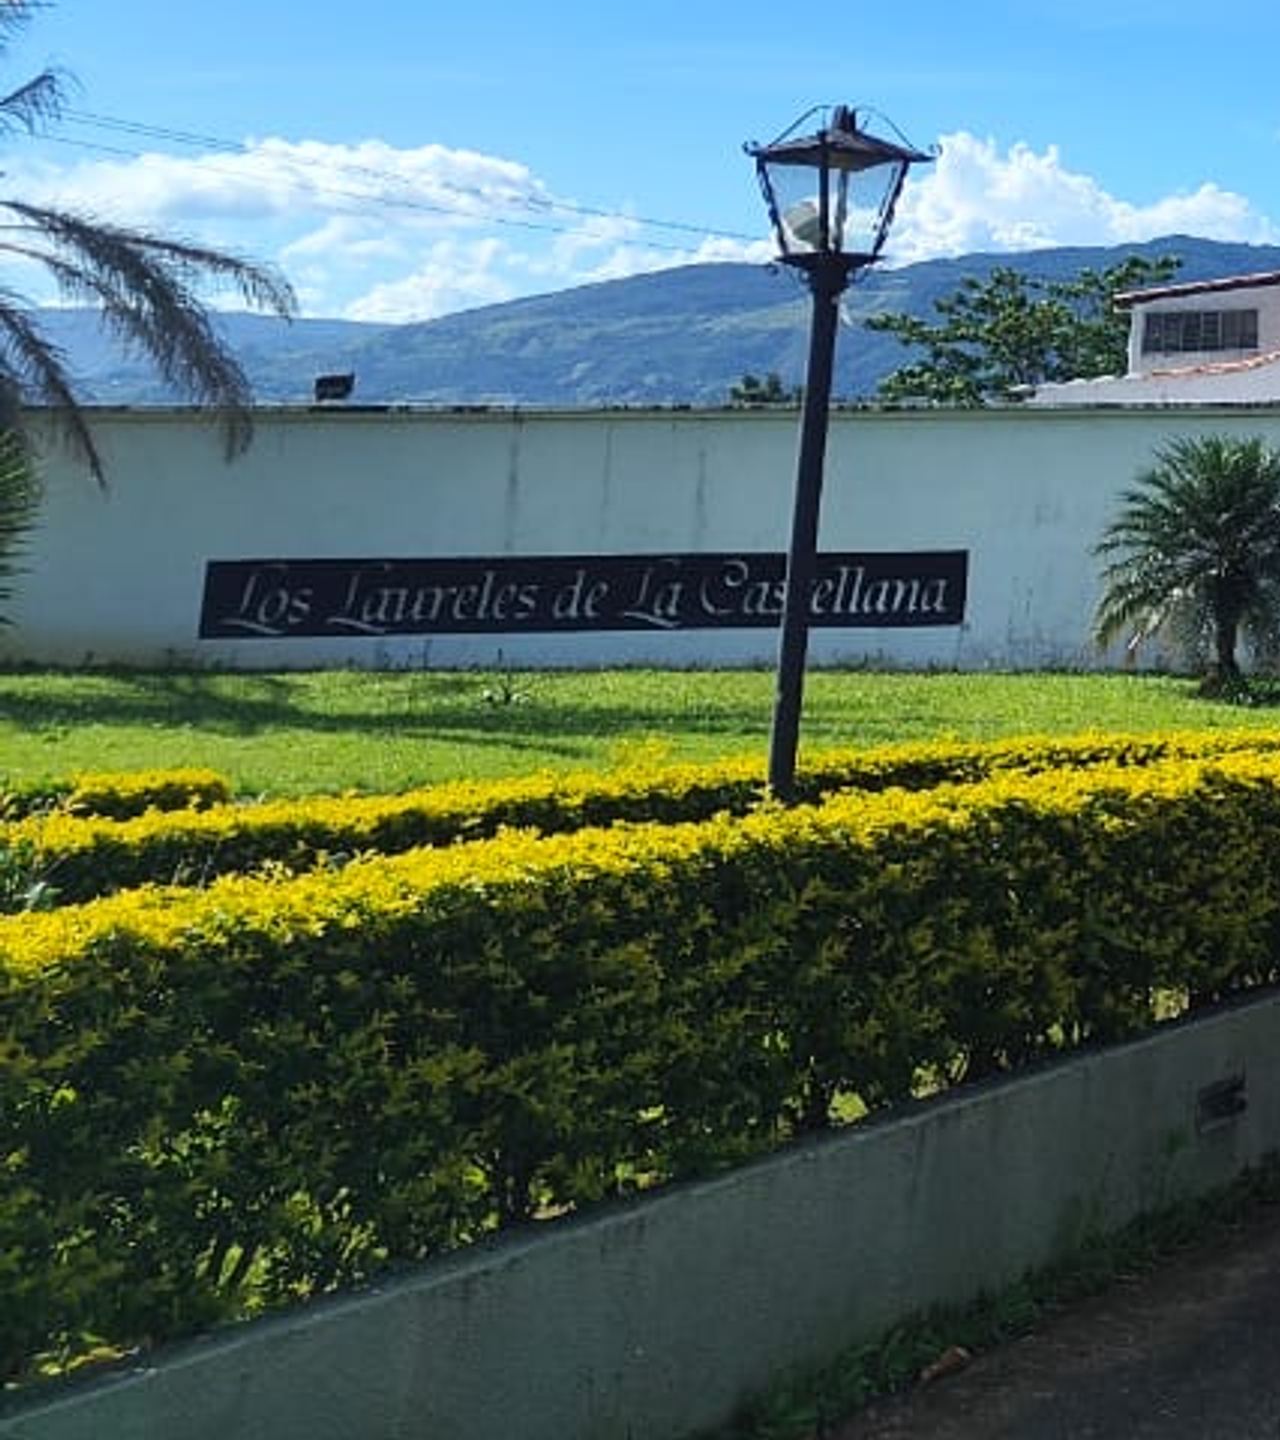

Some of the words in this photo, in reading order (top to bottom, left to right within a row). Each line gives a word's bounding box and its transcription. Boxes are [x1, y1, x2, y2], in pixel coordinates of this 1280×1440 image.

[219, 563, 313, 635] Los
[326, 562, 540, 635] Laureles
[552, 568, 609, 618] de
[623, 558, 683, 628] La
[701, 558, 948, 615] Casellana
